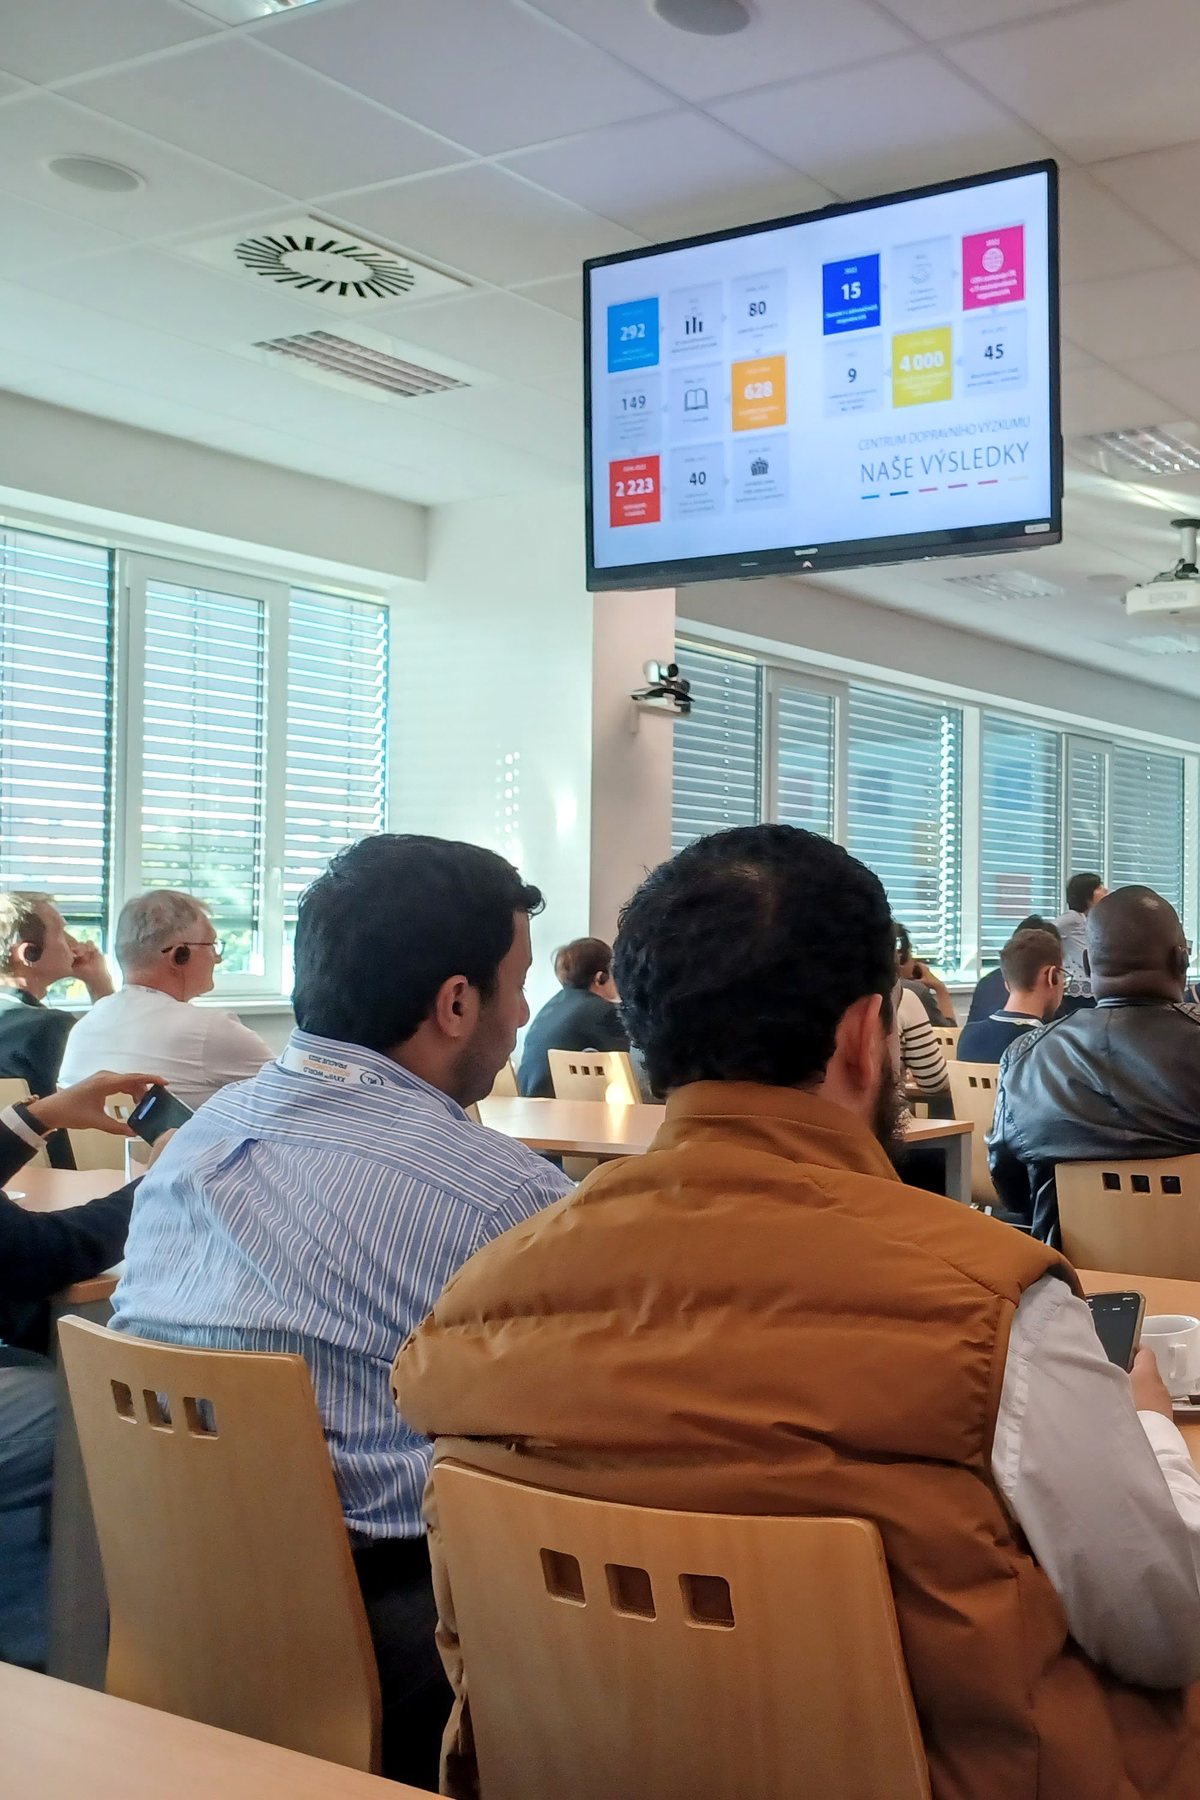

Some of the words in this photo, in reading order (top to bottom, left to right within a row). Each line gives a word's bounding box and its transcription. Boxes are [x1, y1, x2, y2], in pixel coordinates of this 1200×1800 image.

[841, 281, 862, 300] 15
[748, 301, 767, 317] 80
[620, 323, 646, 341] 292
[984, 343, 1005, 360] 45
[899, 355, 911, 372] 4
[913, 350, 944, 370] 000
[848, 368, 857, 383] 9
[744, 381, 774, 400] 628
[622, 395, 646, 411] 149
[858, 434, 907, 451] CENTRUM
[861, 455, 914, 483] NAŠE
[920, 441, 1030, 476] VÝSLEDKY
[615, 481, 625, 497] 2
[627, 477, 654, 495] 223
[689, 471, 706, 486] 40
[323, 1058, 348, 1070] PRAGUE
